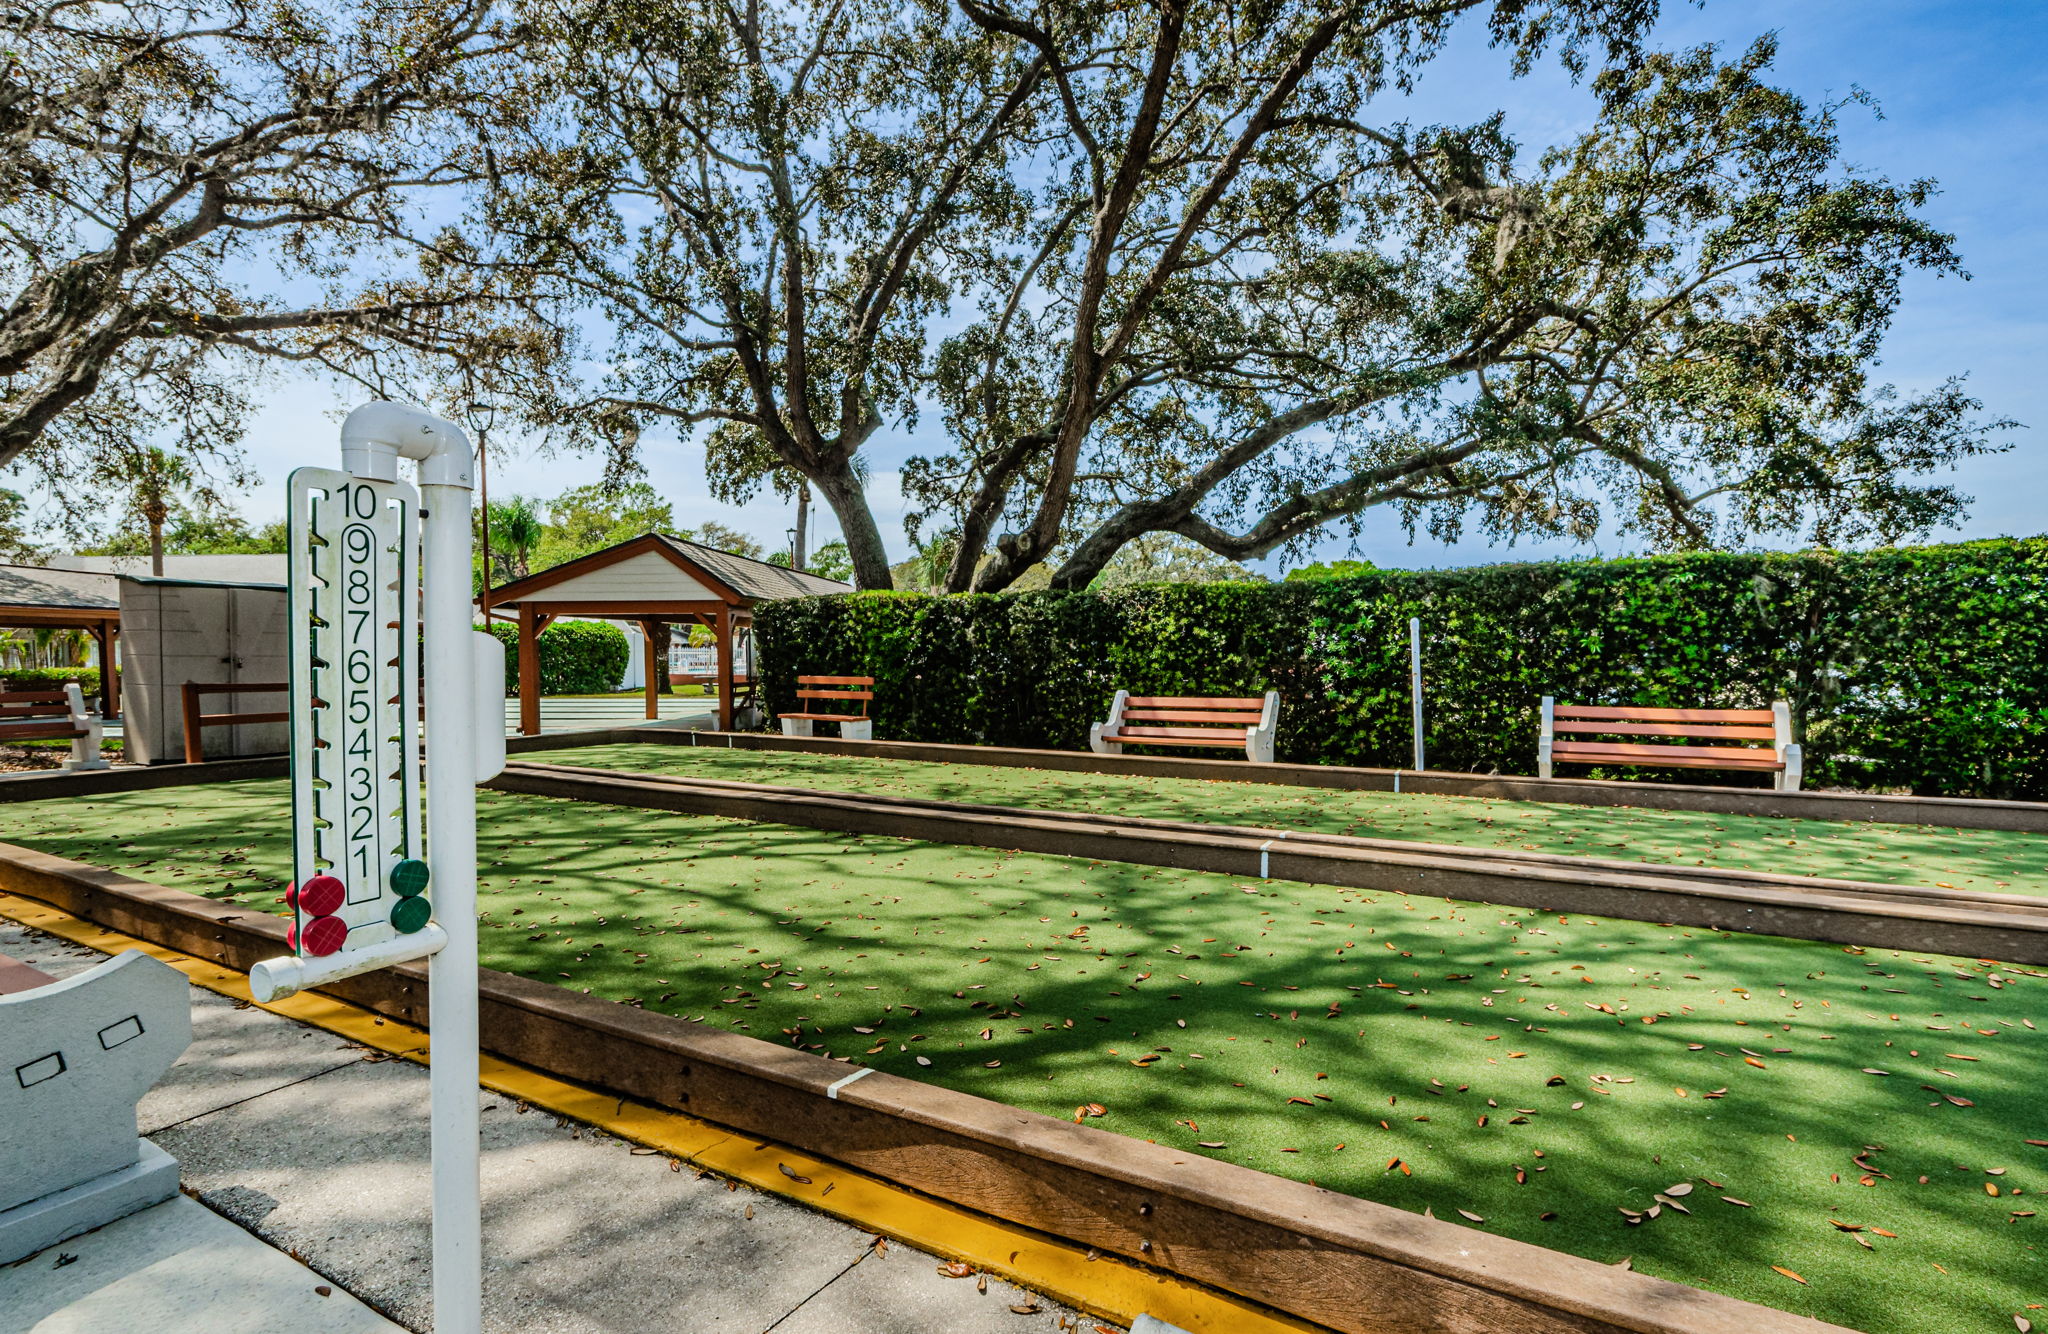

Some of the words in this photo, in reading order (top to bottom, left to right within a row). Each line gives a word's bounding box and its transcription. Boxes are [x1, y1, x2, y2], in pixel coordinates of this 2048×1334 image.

[336, 482, 377, 520] 10
[347, 528, 370, 564] 9
[347, 569, 370, 604] 8
[348, 610, 370, 644] 7
[347, 649, 371, 684] 6
[348, 690, 371, 724] 5
[348, 728, 372, 762] 4
[350, 767, 372, 801] 3
[351, 806, 373, 841] 2
[353, 844, 367, 878] 1
